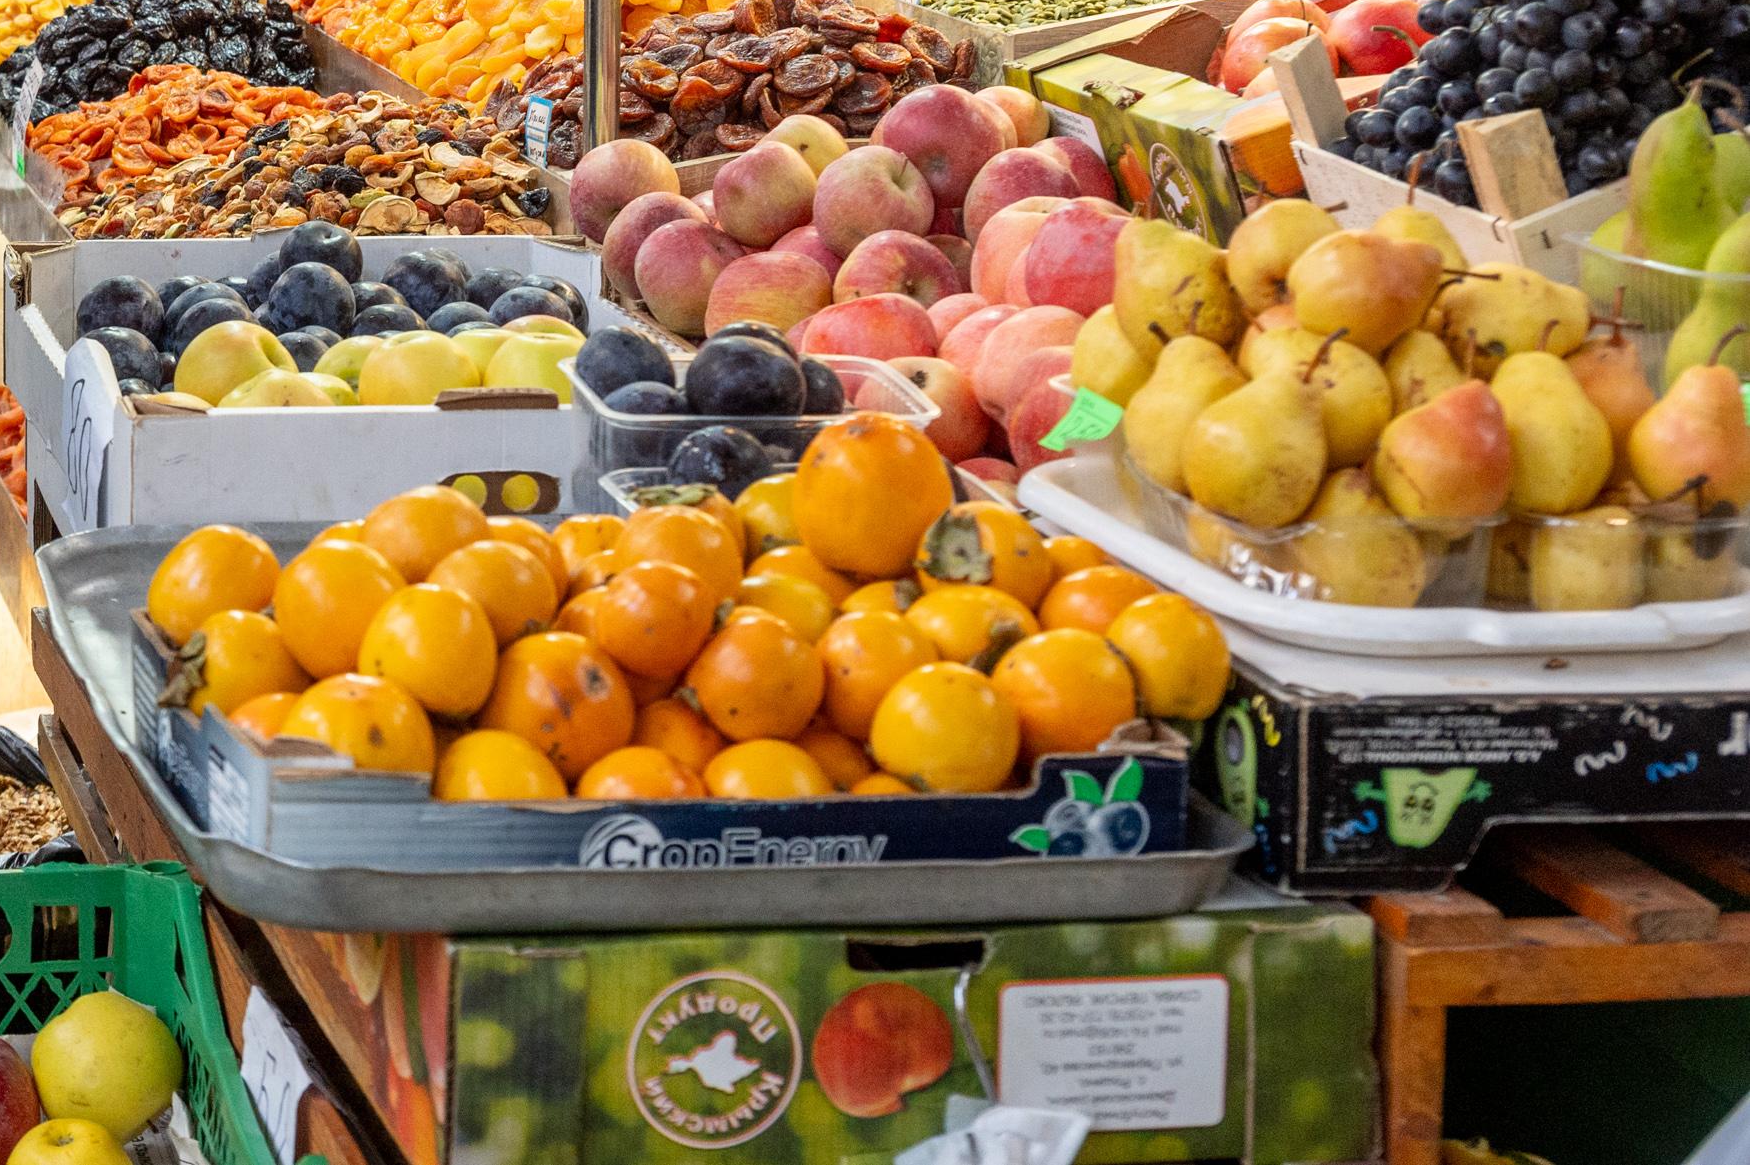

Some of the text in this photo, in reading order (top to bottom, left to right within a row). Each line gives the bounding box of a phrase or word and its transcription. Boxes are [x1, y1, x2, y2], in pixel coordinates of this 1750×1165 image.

[603, 825, 889, 869] CropEnergy
[647, 992, 779, 1044] Продукт
[644, 1070, 784, 1134] Крымский
